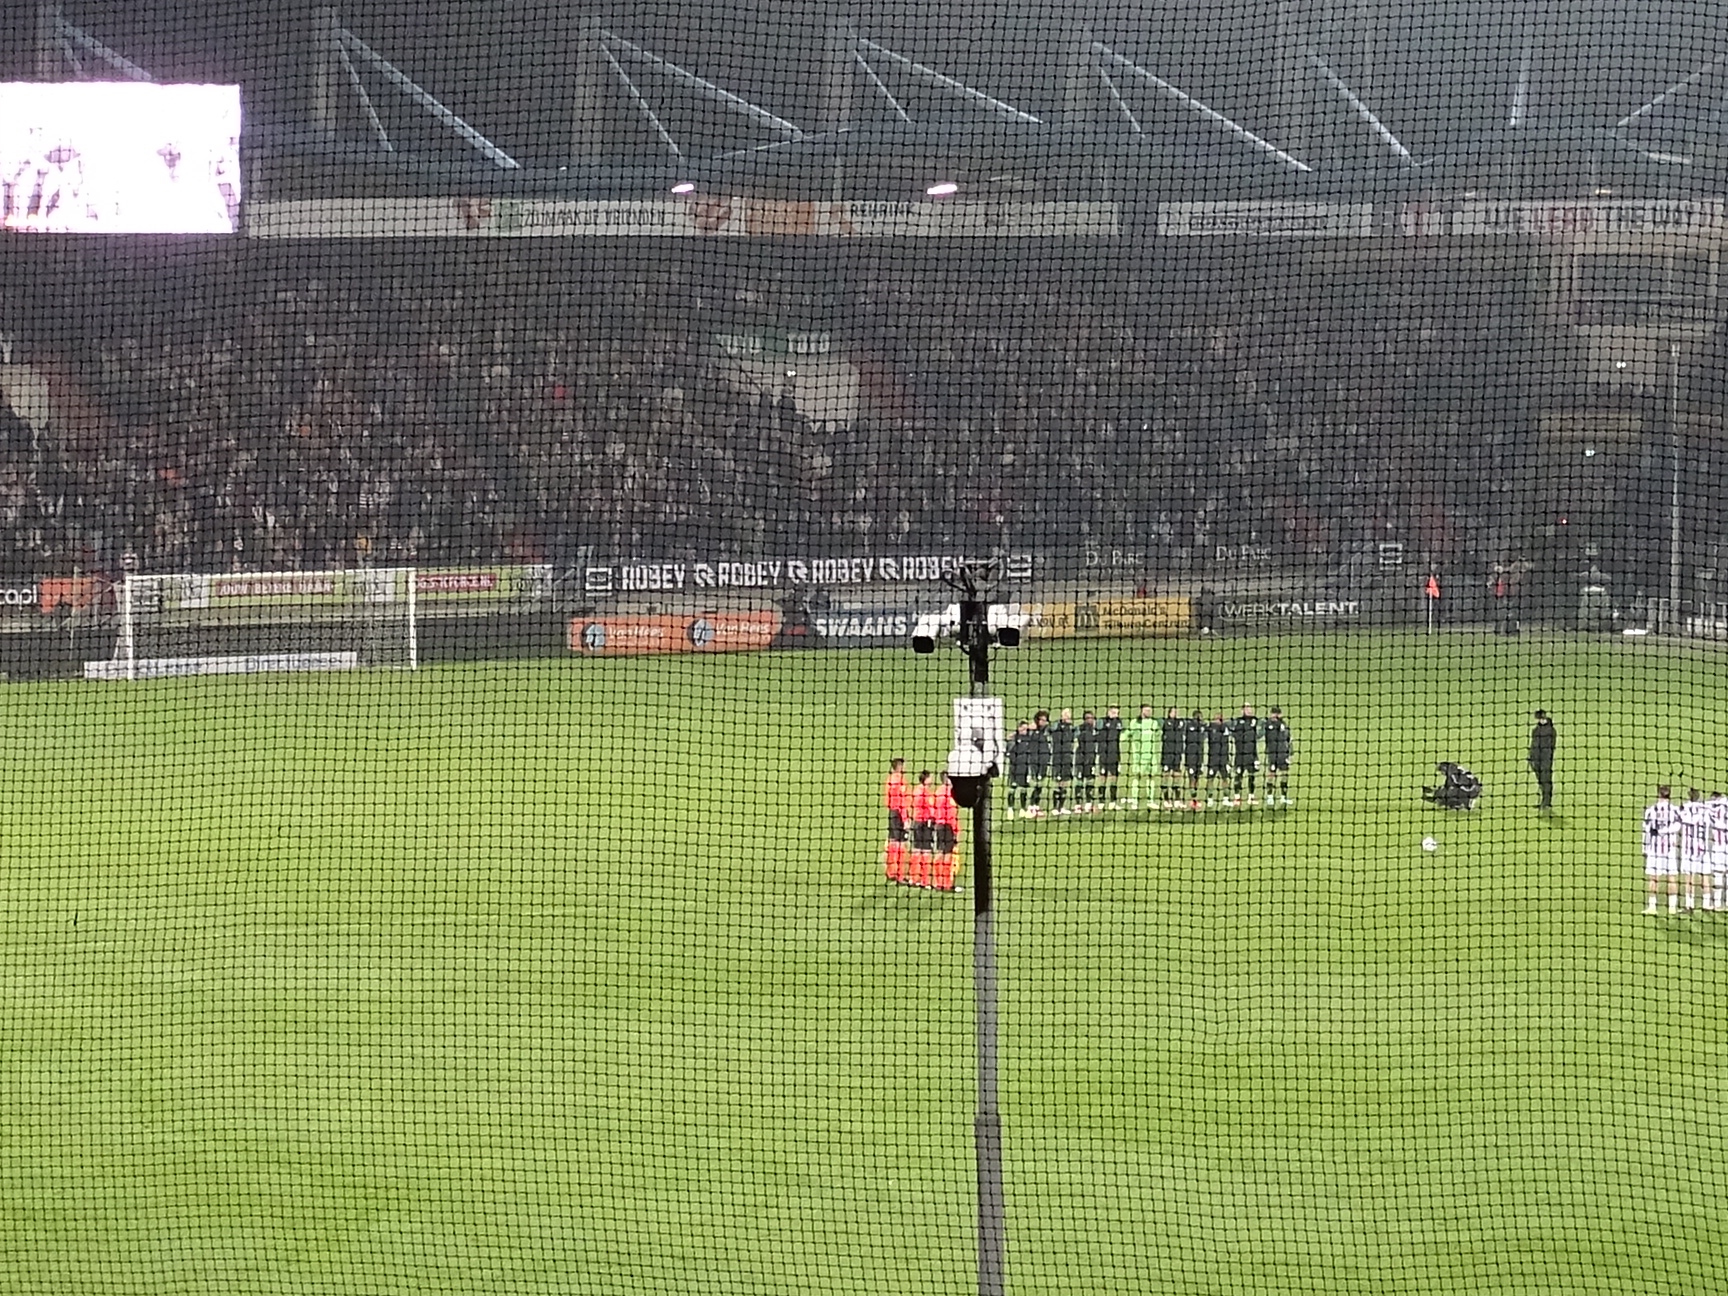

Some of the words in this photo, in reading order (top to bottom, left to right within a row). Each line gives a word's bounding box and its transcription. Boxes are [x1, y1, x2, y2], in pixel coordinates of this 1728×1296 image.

[718, 561, 781, 587] ROBEY
[812, 556, 873, 584] ROBEY
[816, 616, 907, 637] SWAANS
